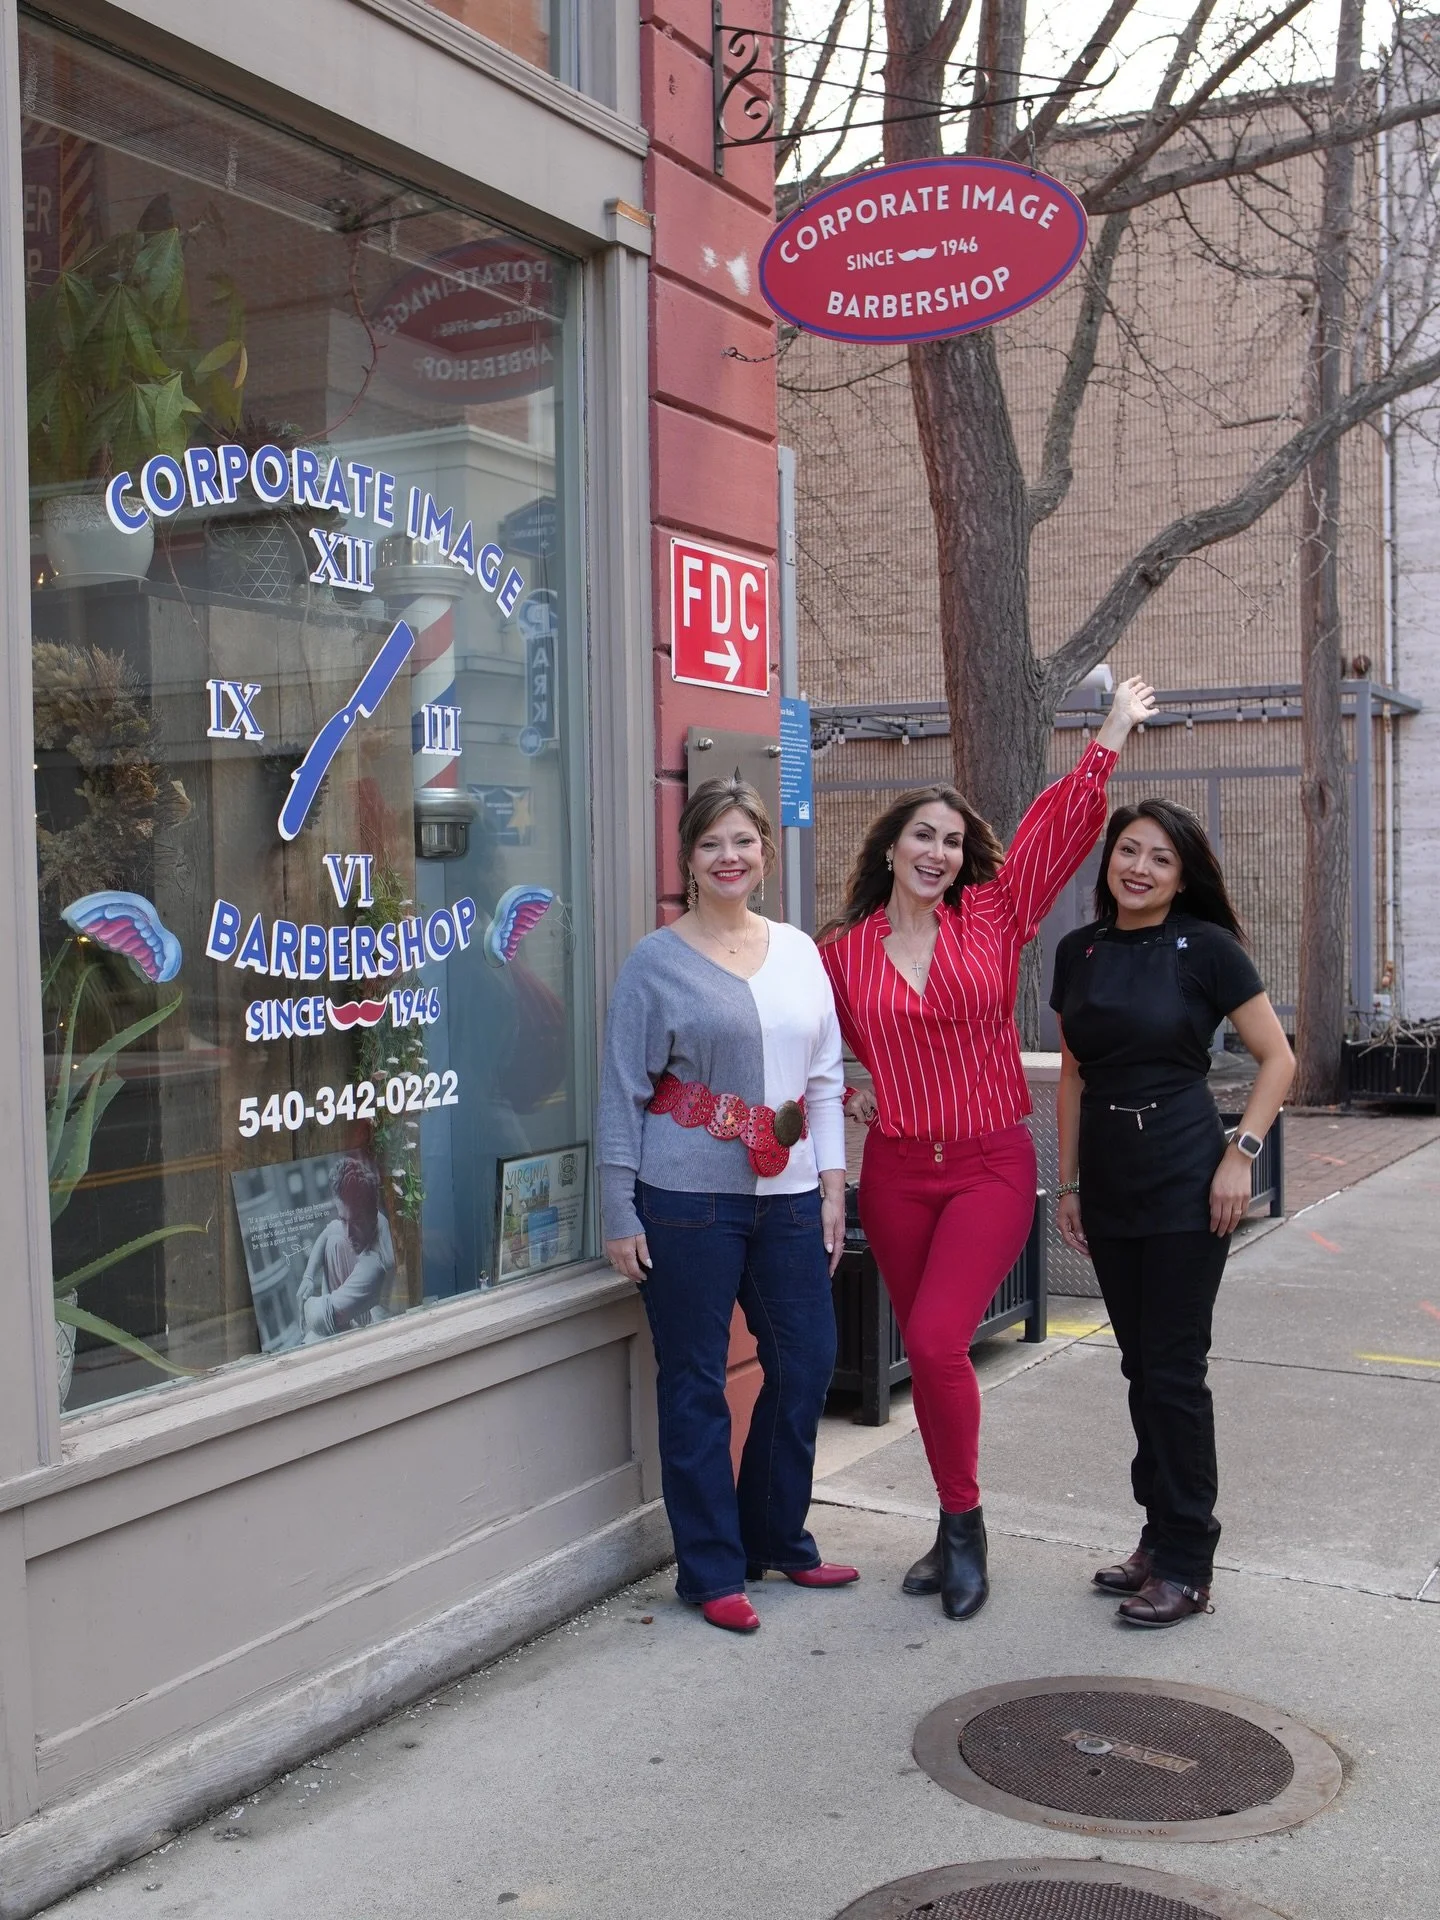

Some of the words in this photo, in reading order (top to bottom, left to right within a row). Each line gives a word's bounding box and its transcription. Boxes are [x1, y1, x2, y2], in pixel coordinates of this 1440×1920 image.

[779, 185, 949, 263] CORPORATE
[962, 184, 1060, 229] IMAGE
[847, 249, 894, 271] SINCE
[941, 236, 978, 257] 1946
[827, 266, 1010, 318] BARBERSHOP
[106, 444, 395, 535] CORPORATE
[407, 486, 525, 618] IMAGE
[309, 528, 375, 592] XII
[683, 555, 760, 641] FDC
[206, 679, 264, 741] IX
[421, 704, 462, 756] III
[322, 854, 374, 908] VI
[206, 896, 477, 981] BARBERSHOP
[246, 996, 326, 1042] SINCE
[389, 987, 441, 1028] 1946
[238, 1070, 459, 1138] 540-342-0222
[506, 1162, 550, 1188] VIRGINIA
